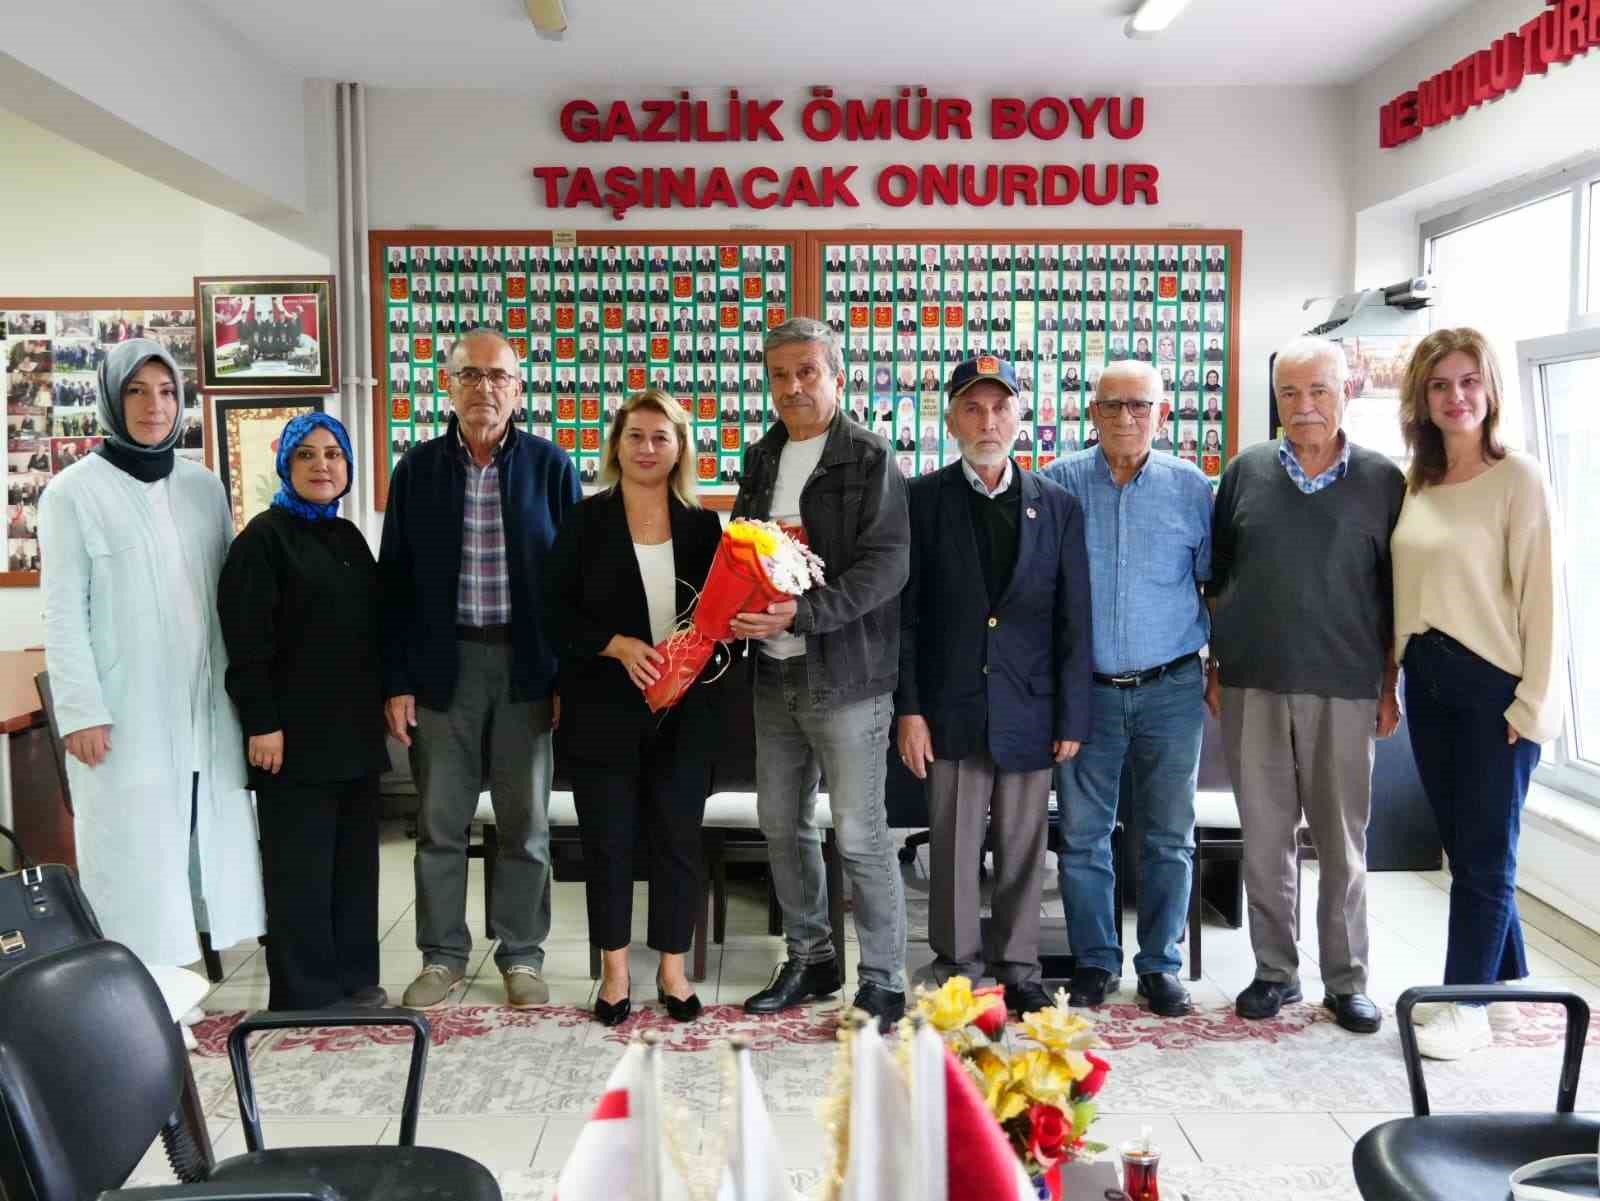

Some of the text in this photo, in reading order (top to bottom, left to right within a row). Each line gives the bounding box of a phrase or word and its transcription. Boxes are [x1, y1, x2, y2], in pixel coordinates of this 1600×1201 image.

[1418, 32, 1526, 128] MUTLU
[559, 84, 1147, 144] GAZİLİK ÖMÜR BOYU
[533, 162, 1161, 220] TAŞINACAK ONURDUR
